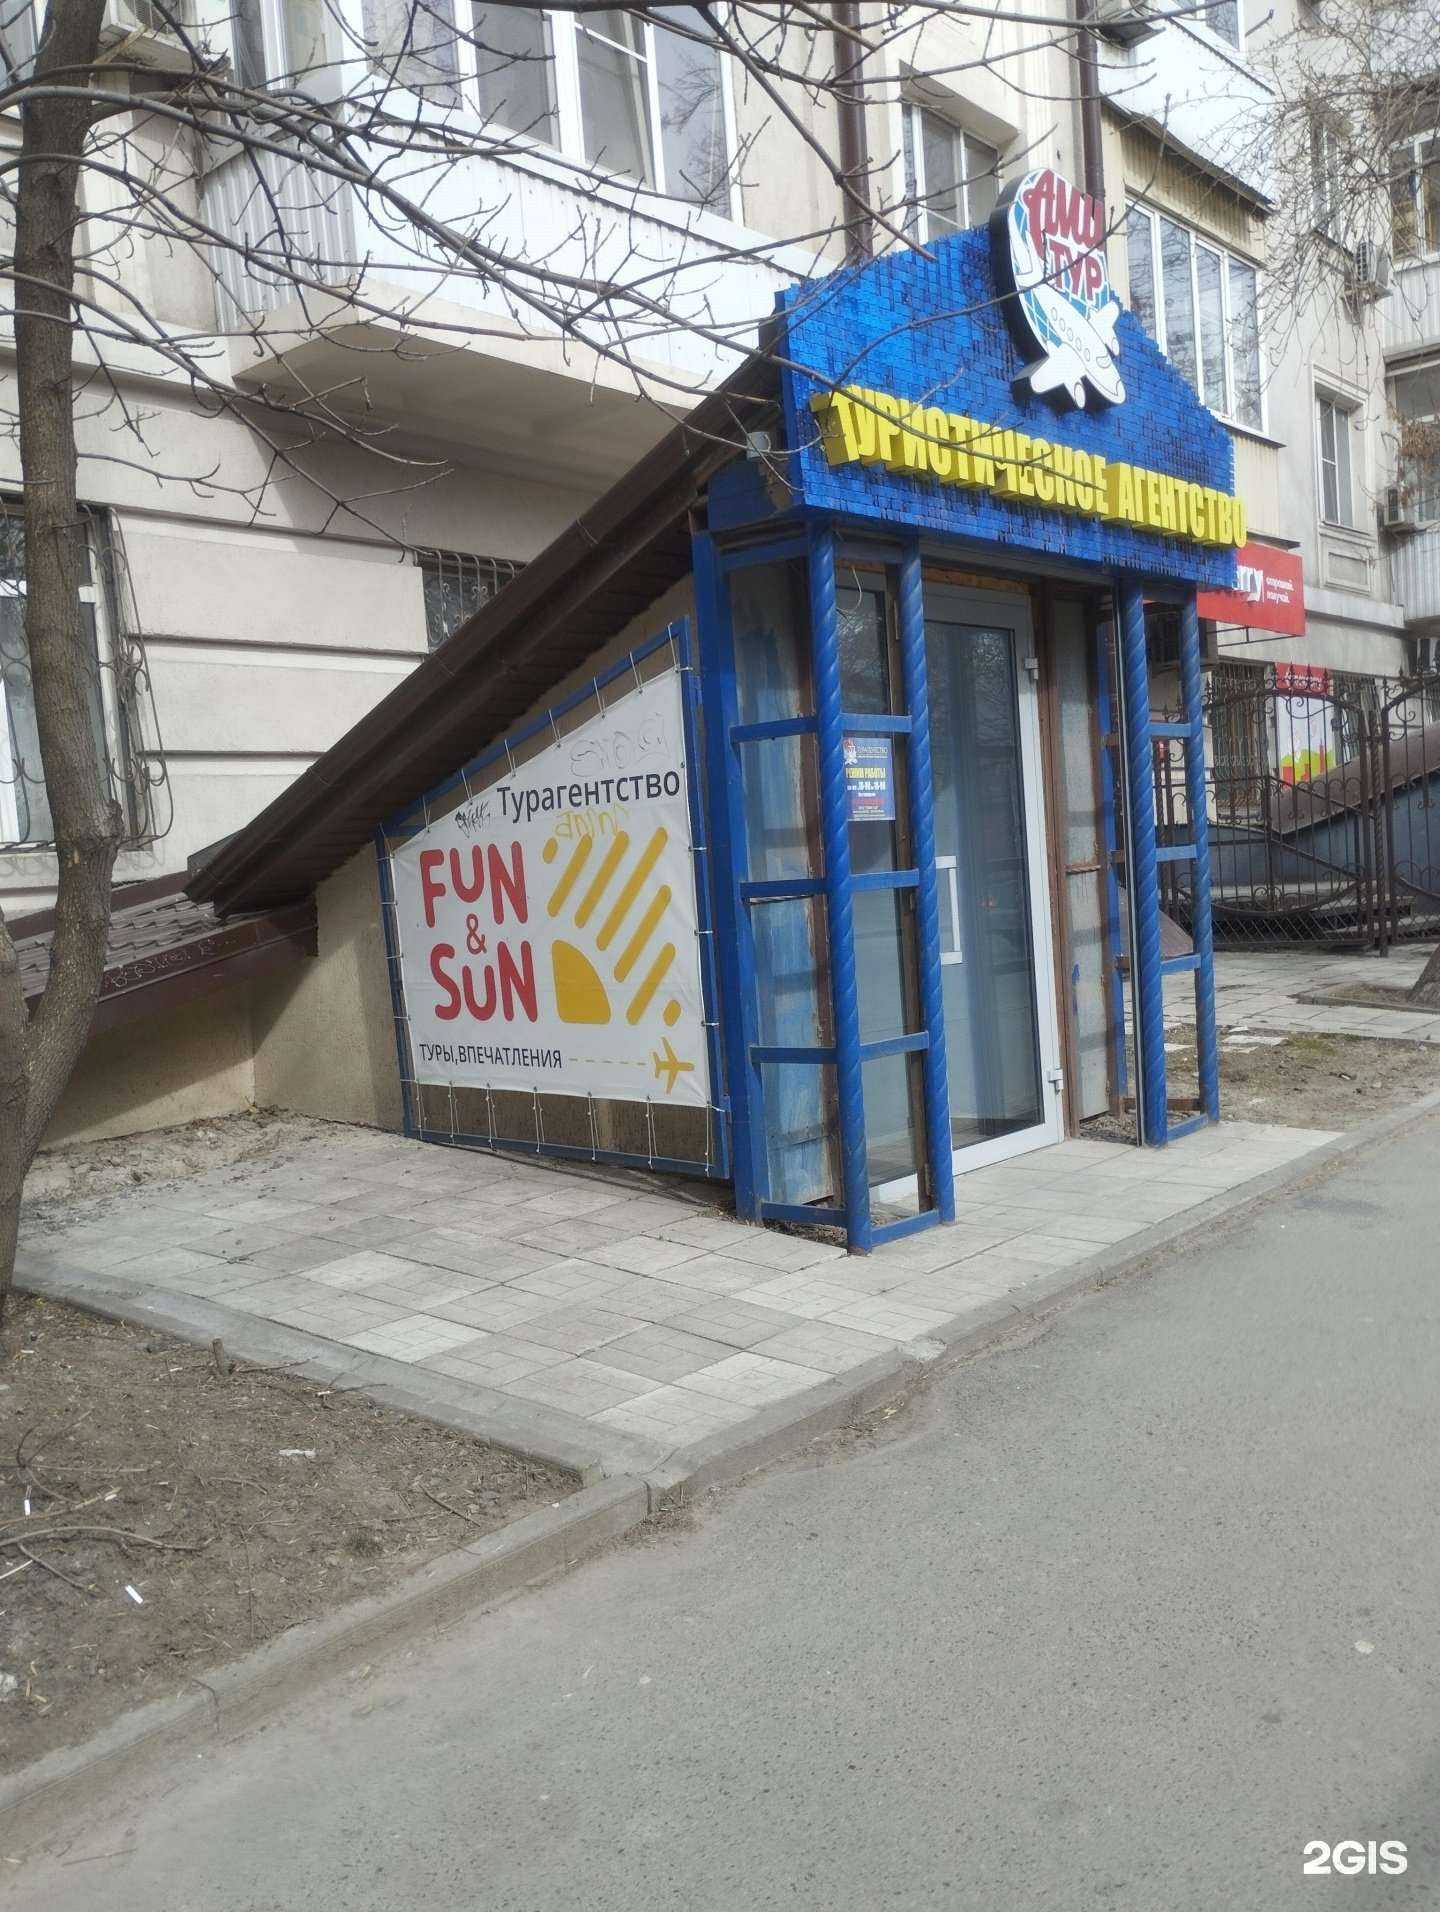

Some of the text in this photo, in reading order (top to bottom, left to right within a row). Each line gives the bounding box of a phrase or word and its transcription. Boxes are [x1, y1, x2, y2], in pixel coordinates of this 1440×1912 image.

[1049, 239, 1102, 301] ТУР
[824, 384, 1248, 548] ТУРИСТИЧЕСКОЕ АГЕНТСТВО
[496, 771, 681, 823] Турагентство
[419, 841, 528, 928] FUN
[466, 914, 487, 954] &
[430, 941, 538, 1023] SUN
[419, 1043, 562, 1069] ТУРЫ,ВПЕЧАТЛЕНИЯ
